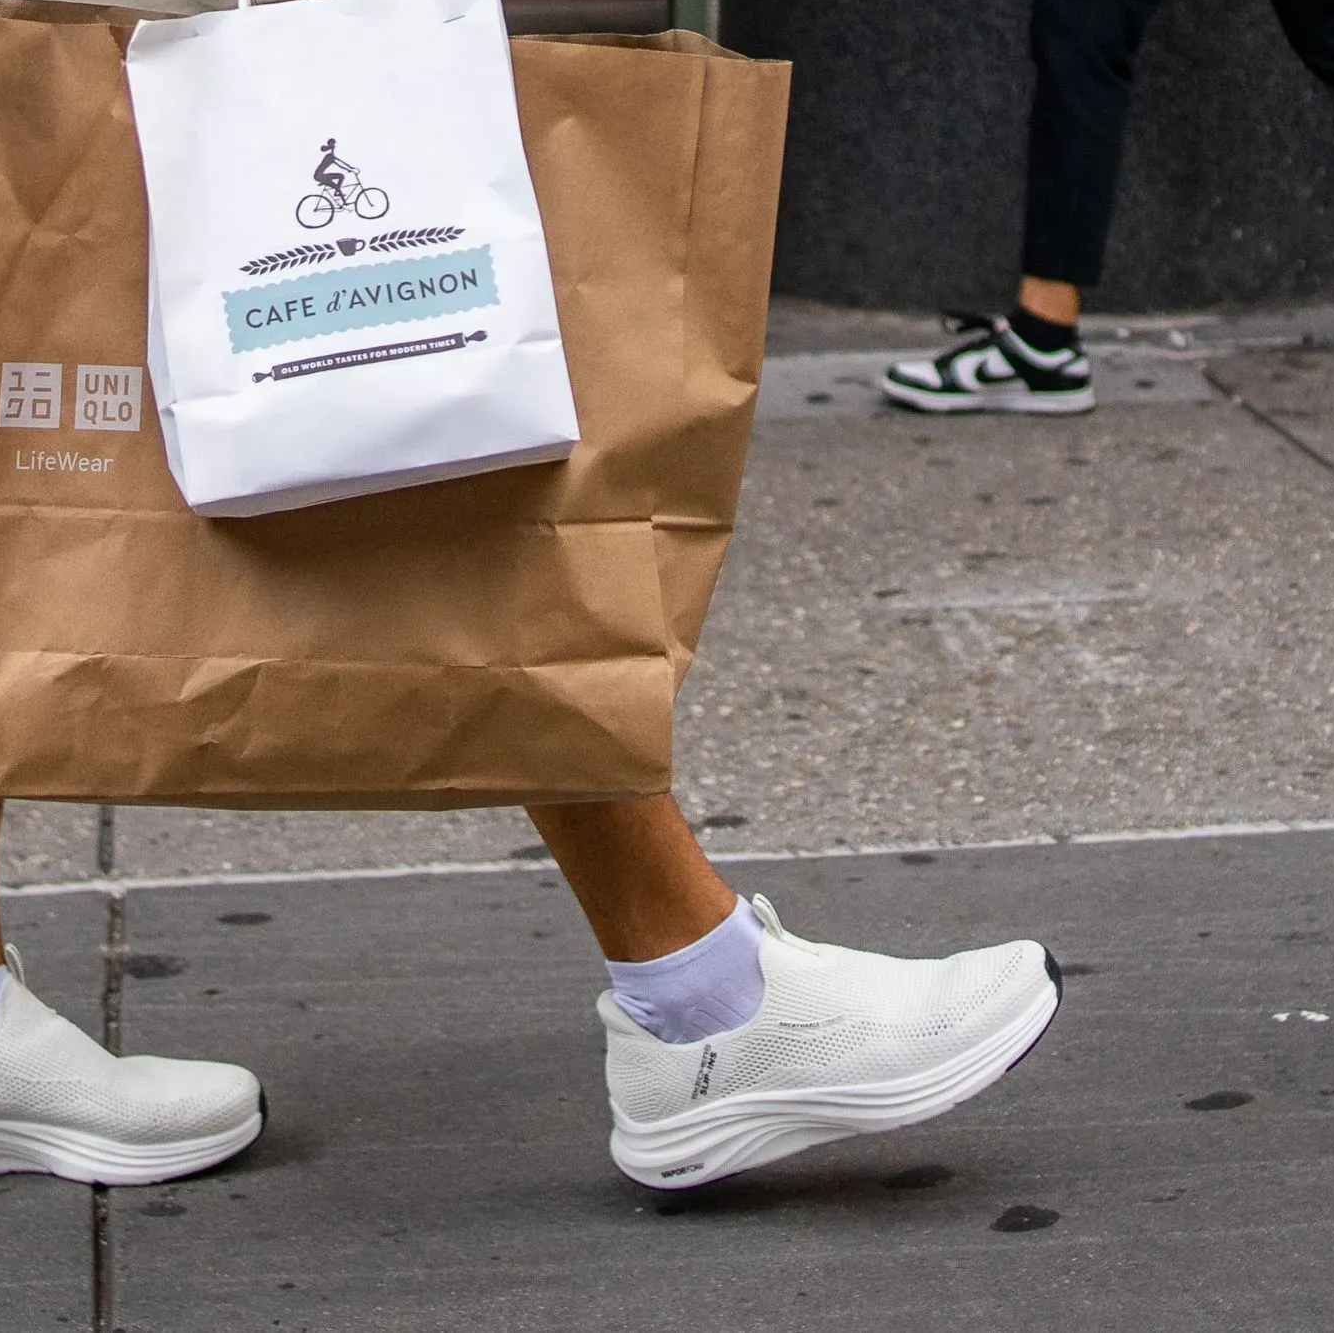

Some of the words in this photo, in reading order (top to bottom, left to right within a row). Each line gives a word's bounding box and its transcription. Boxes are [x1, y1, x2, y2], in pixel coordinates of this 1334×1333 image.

[245, 296, 316, 329] CAFE
[326, 268, 479, 313] d'AVIGNON
[281, 365, 299, 375] OLD
[301, 358, 334, 370] WORLD
[335, 352, 369, 364] TASTES
[369, 350, 388, 359] FOR
[389, 343, 427, 356] MODERN
[428, 338, 456, 349] TIMES
[84, 373, 130, 396] UNI
[83, 400, 133, 425] QLO
[16, 450, 114, 473] LifeWear
